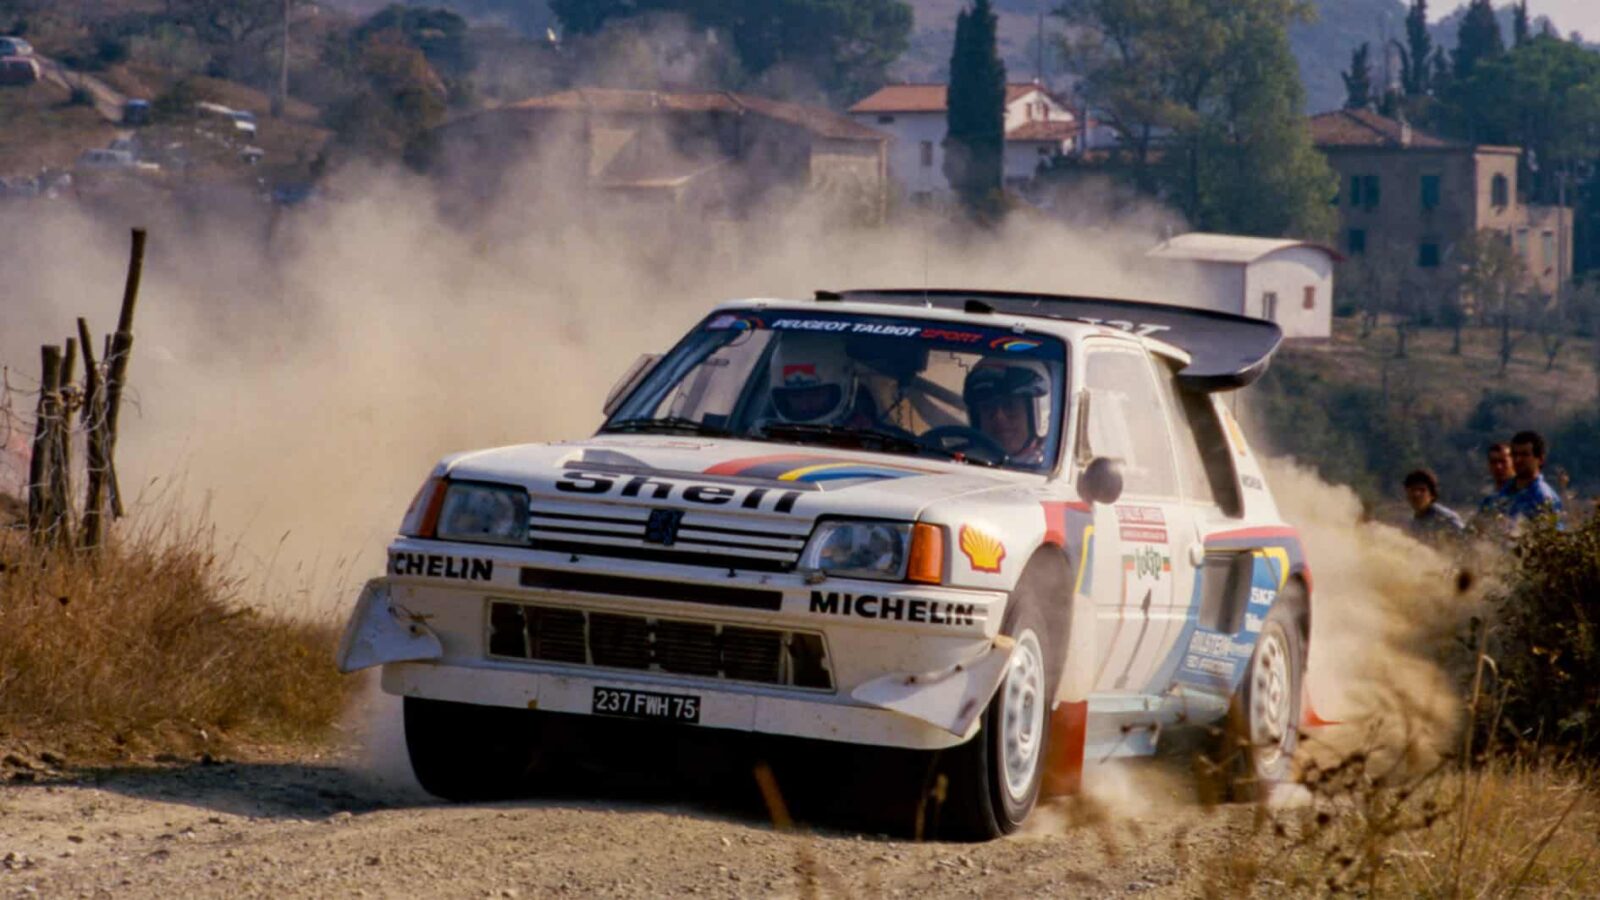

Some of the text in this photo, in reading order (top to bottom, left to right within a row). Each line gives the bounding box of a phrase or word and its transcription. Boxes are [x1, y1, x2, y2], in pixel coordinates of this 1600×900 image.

[771, 318, 983, 343] PEUGEOT TALBOT SPORT
[555, 471, 801, 513] Shell
[809, 590, 975, 627] MICHELIN
[1250, 587, 1276, 605] SKF
[596, 690, 696, 718] 237 FWH 75
